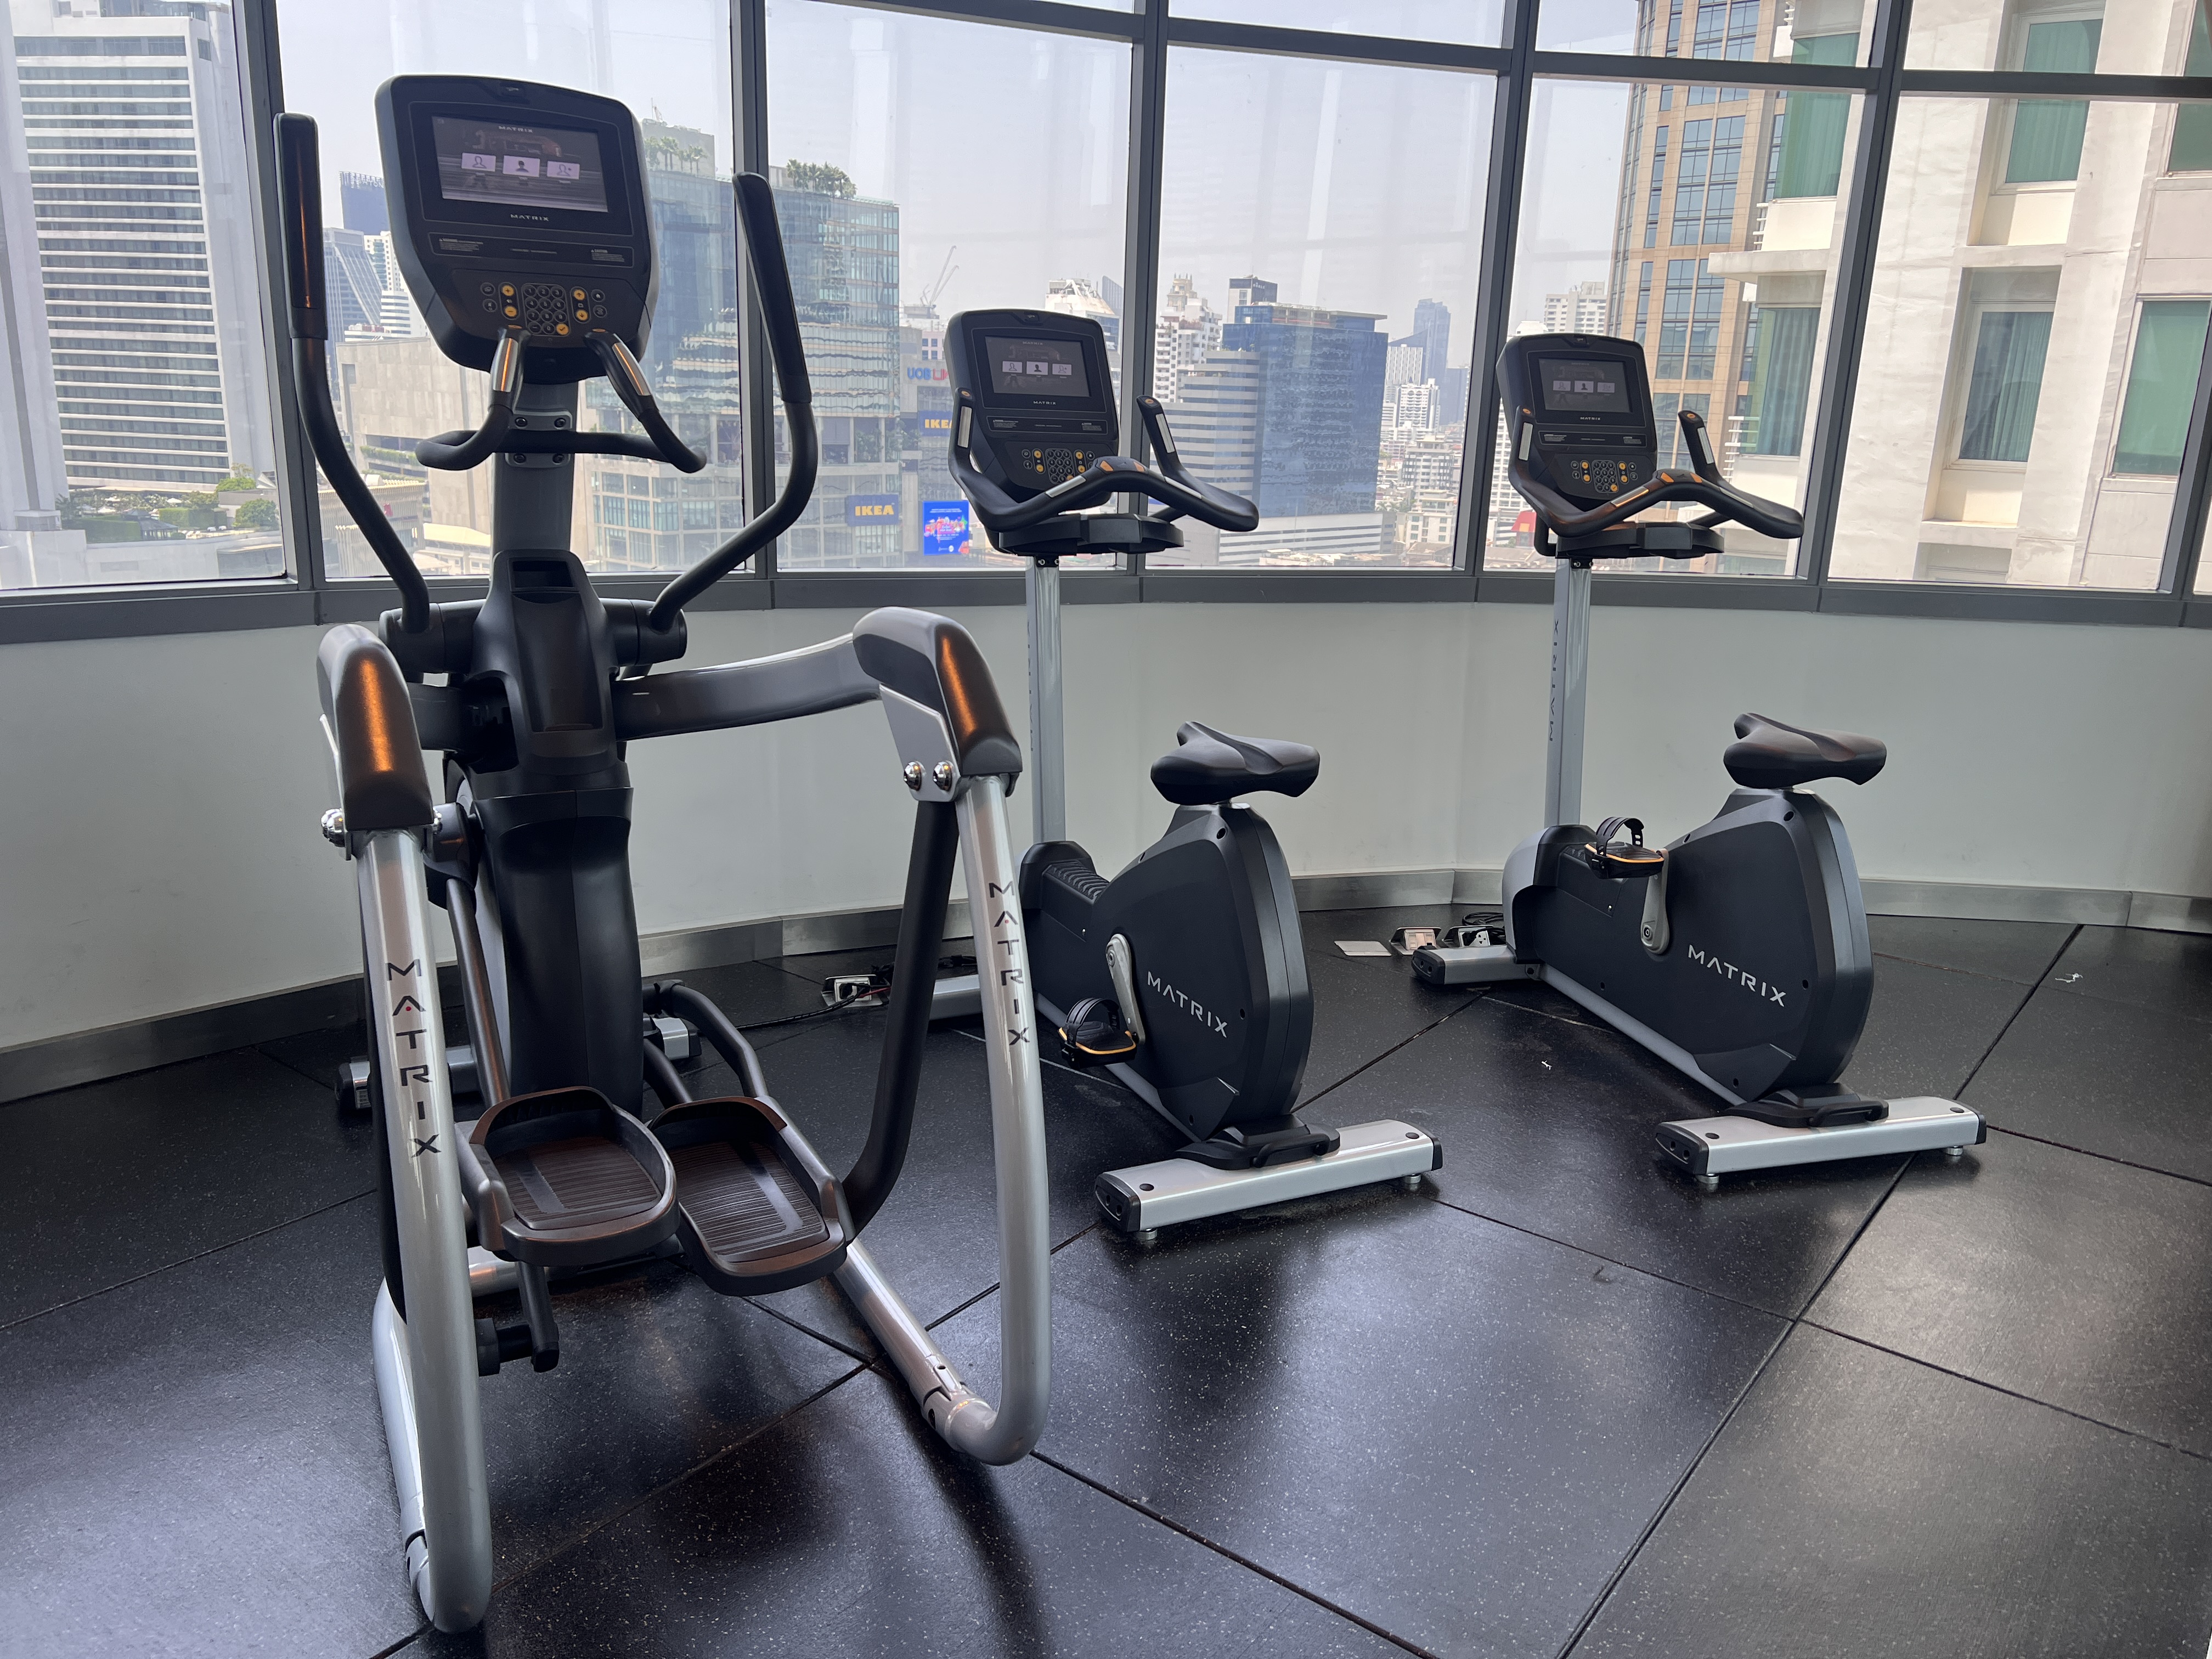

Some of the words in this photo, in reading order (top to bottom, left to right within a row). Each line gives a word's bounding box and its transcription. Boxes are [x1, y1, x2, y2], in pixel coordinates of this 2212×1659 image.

[907, 367, 931, 380] UOB
[855, 505, 894, 516] IKEA
[989, 880, 1030, 1045] MATRIX
[1688, 944, 1786, 1007] MATRIX
[1148, 970, 1228, 1038] MATRIX
[386, 958, 442, 1158] MATRIX
